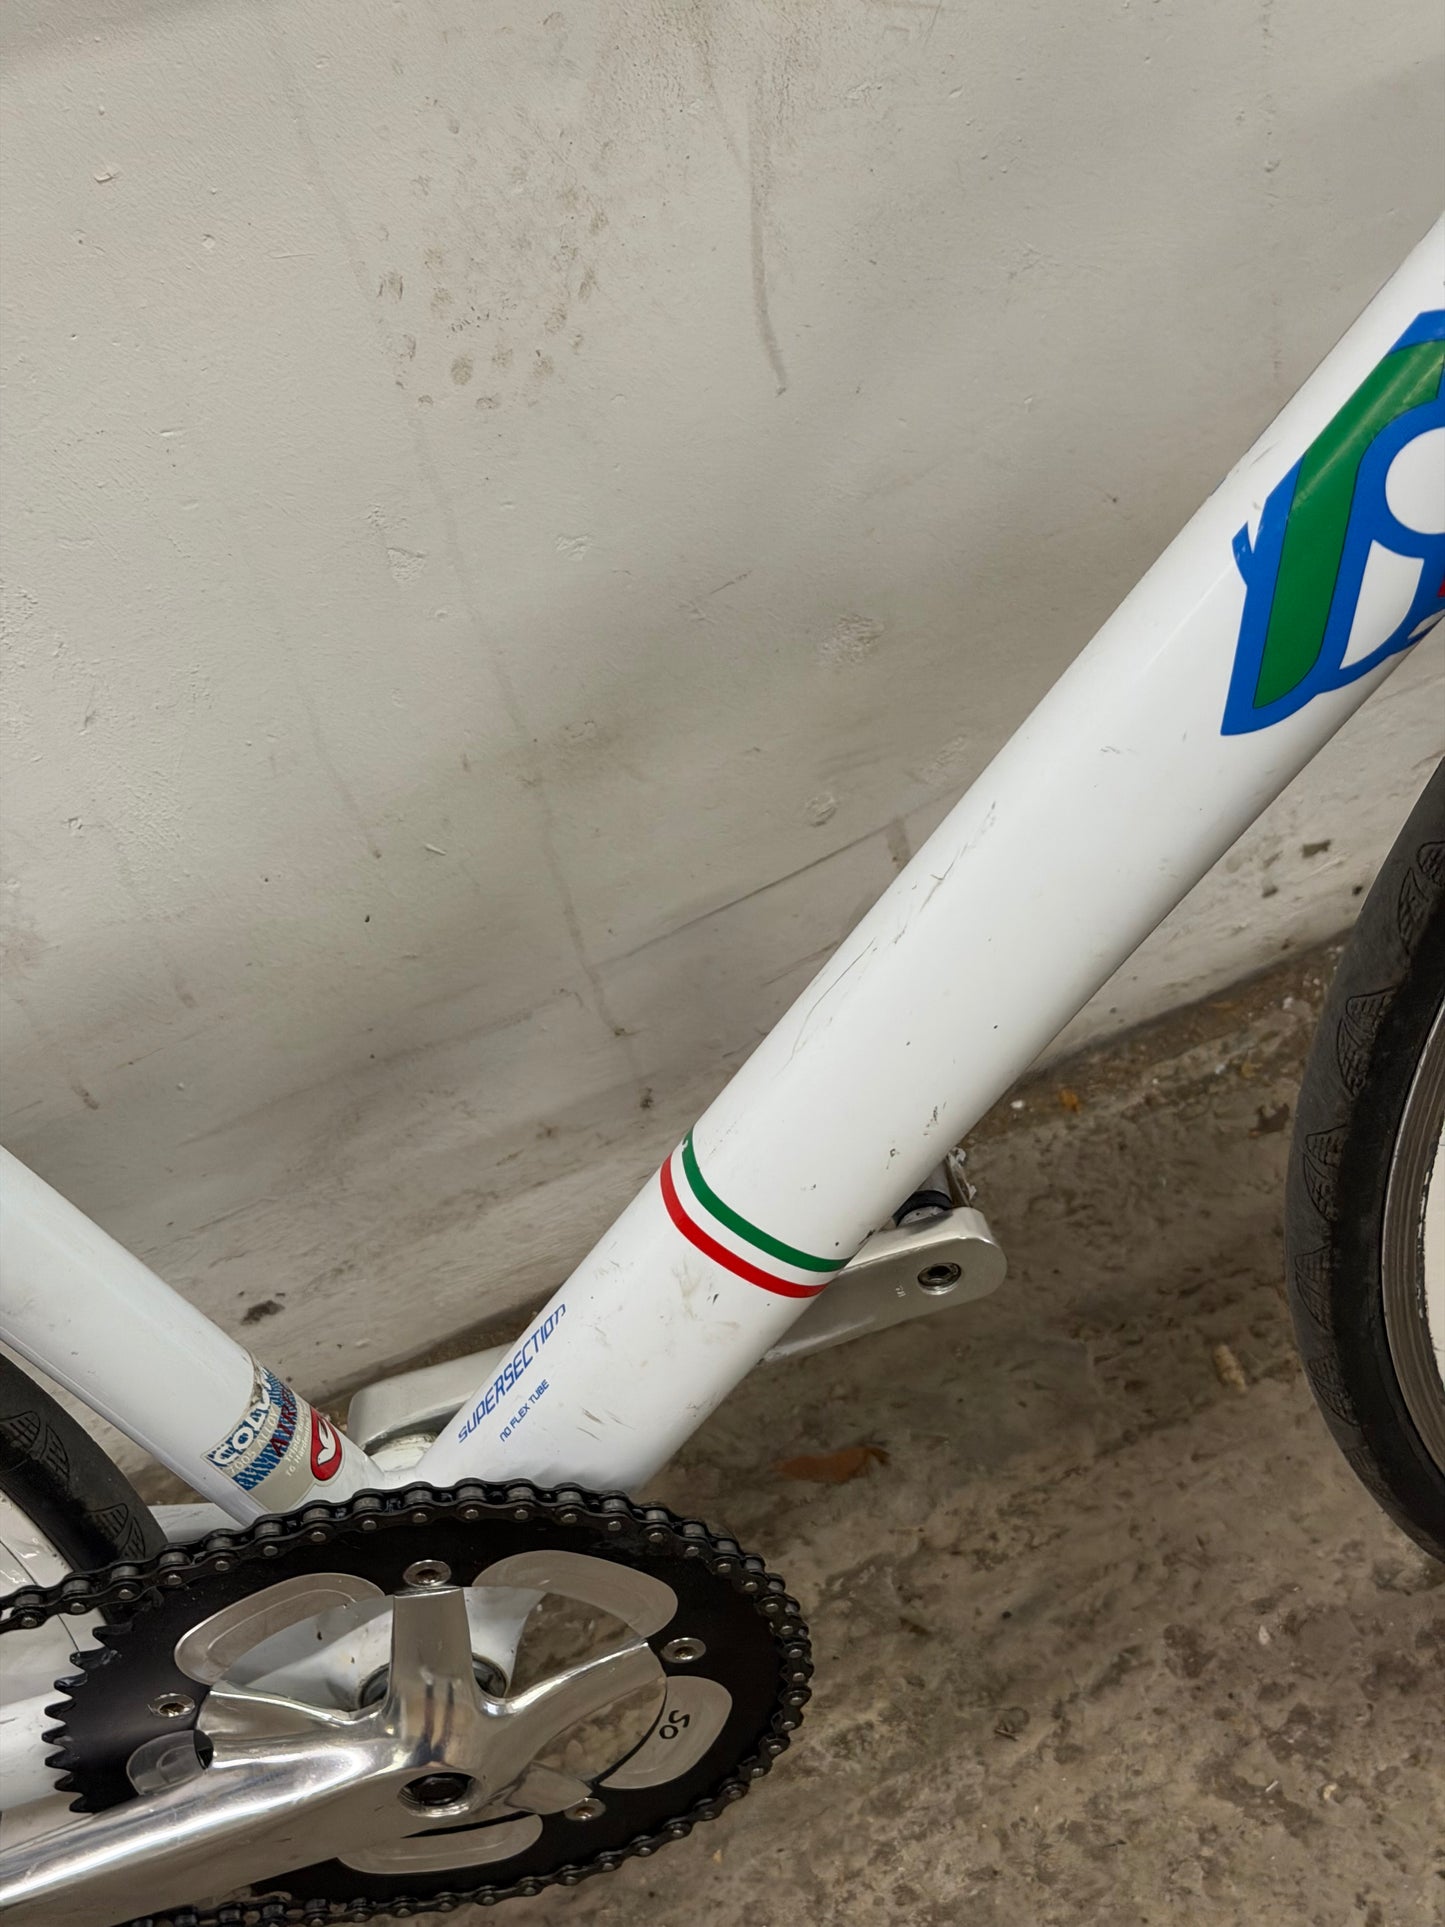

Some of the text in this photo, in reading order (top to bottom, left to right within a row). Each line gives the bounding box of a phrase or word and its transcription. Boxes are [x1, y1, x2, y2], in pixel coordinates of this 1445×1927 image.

[458, 1303, 566, 1443] SUPERSECTION
[257, 1407, 280, 1449] ALLOY
[500, 1379, 549, 1442] NO FLEX TUBE
[659, 1709, 690, 1739] 50
